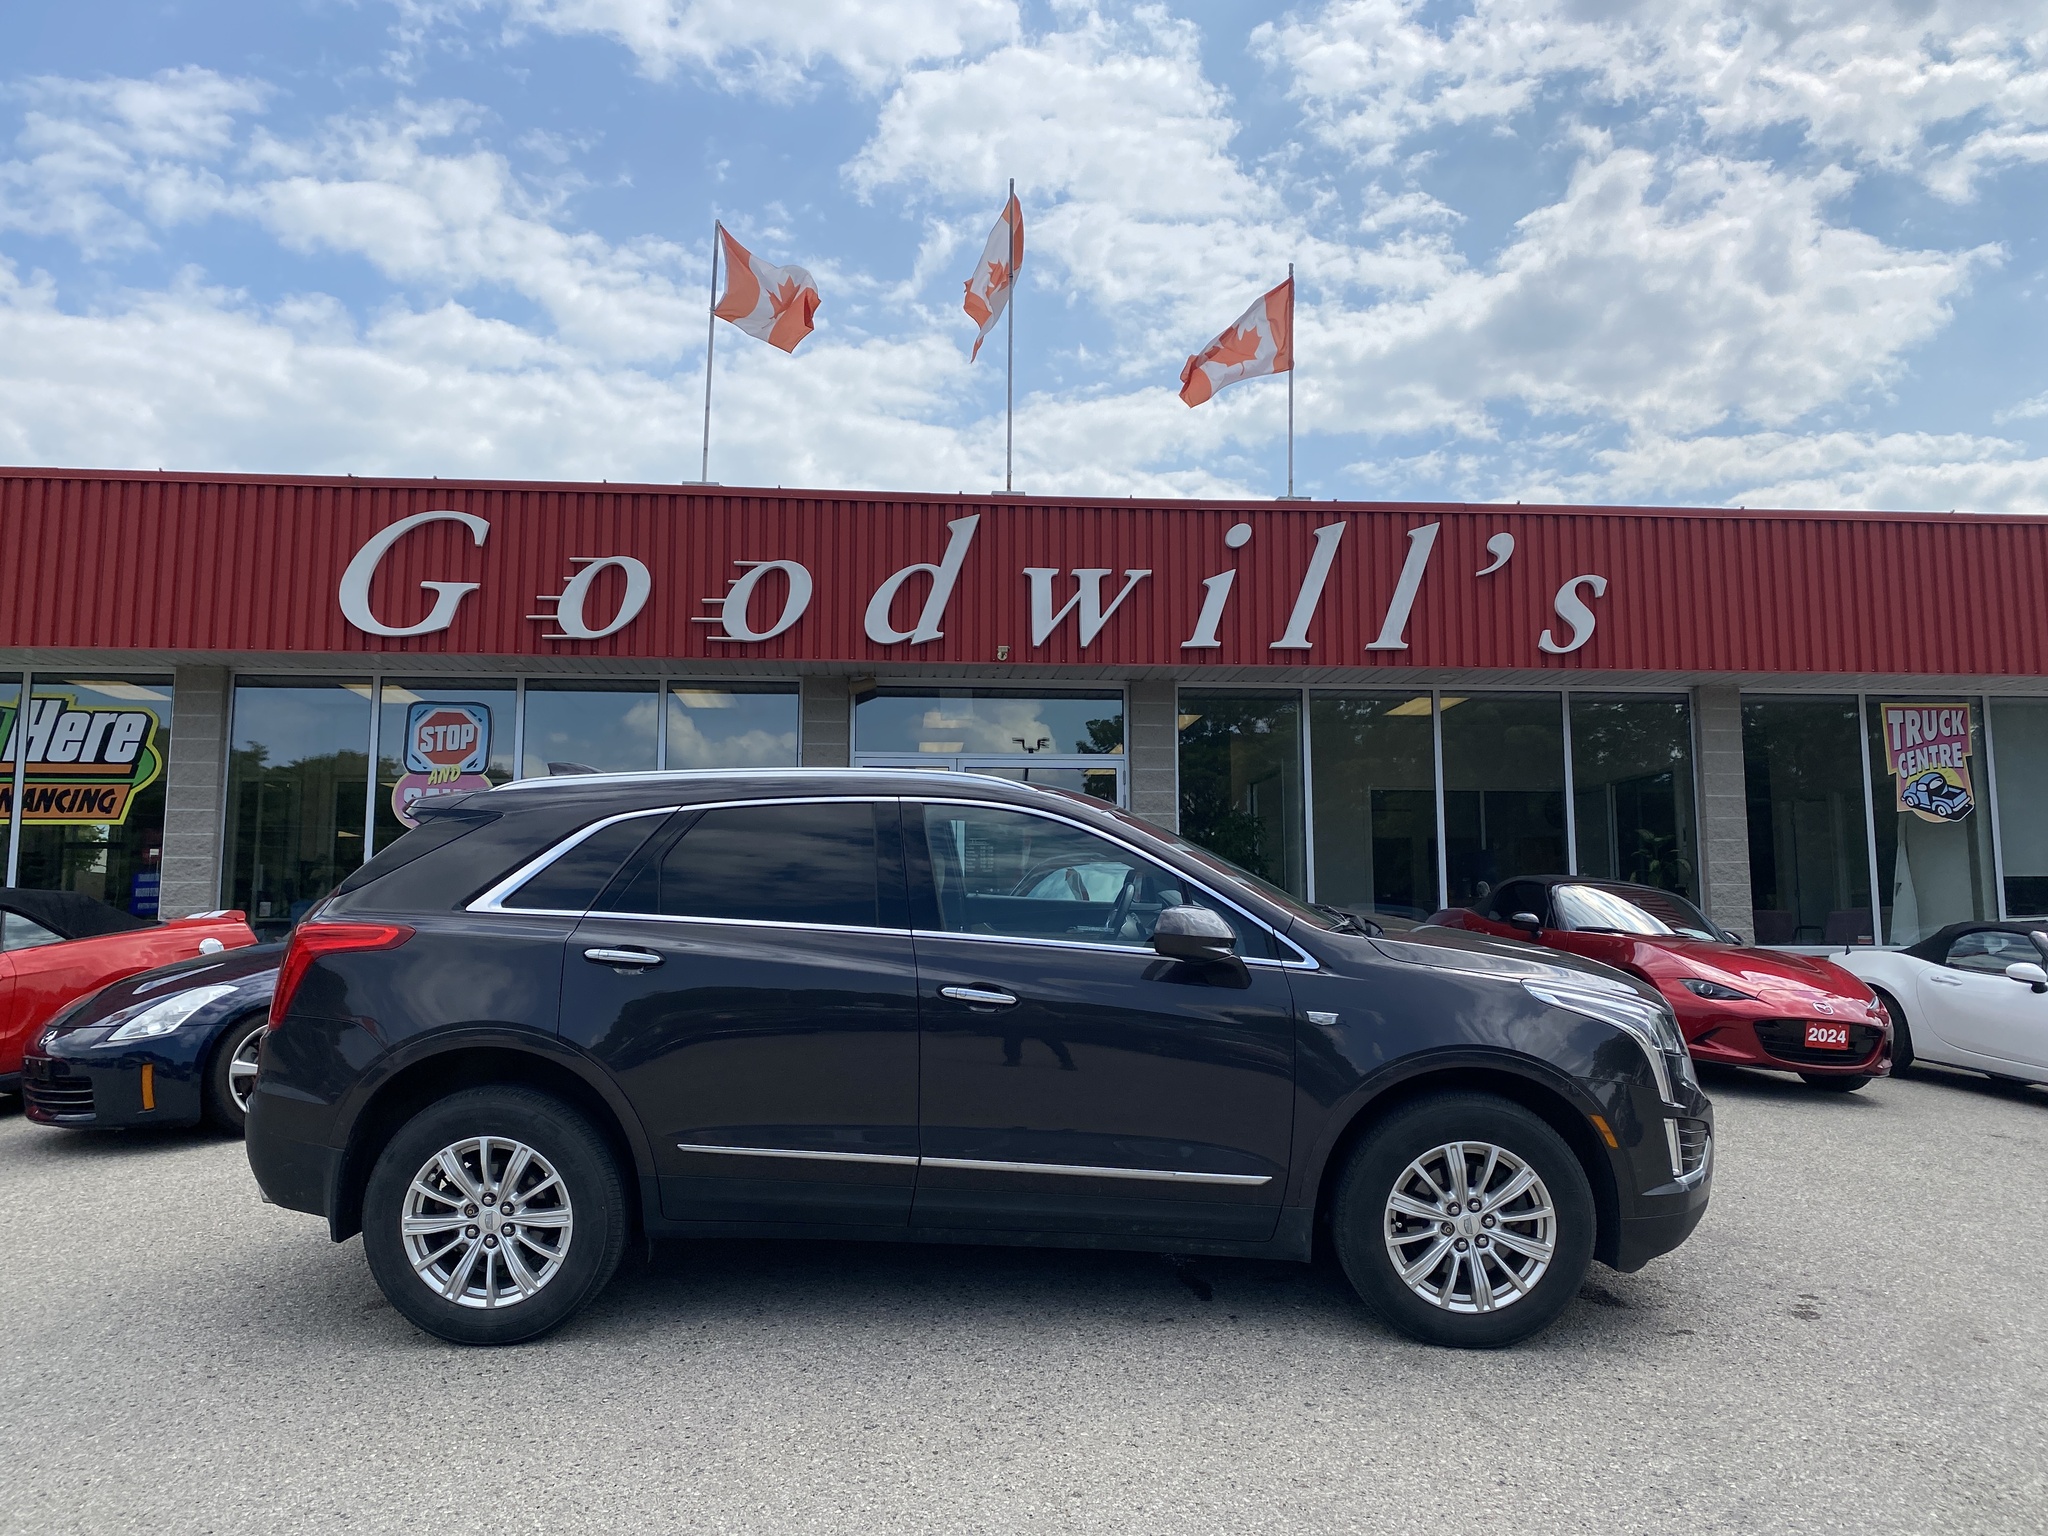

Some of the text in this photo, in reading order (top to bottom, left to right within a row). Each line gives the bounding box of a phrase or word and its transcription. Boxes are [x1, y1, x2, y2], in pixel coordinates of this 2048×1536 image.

[338, 510, 1608, 654] Goodwill's
[2, 699, 148, 763] Here
[419, 723, 475, 753] STOP
[1887, 709, 1966, 751] TRUCK
[427, 764, 462, 786] AND
[1897, 741, 1964, 779] CENTRE
[1807, 1027, 1846, 1044] 2024
